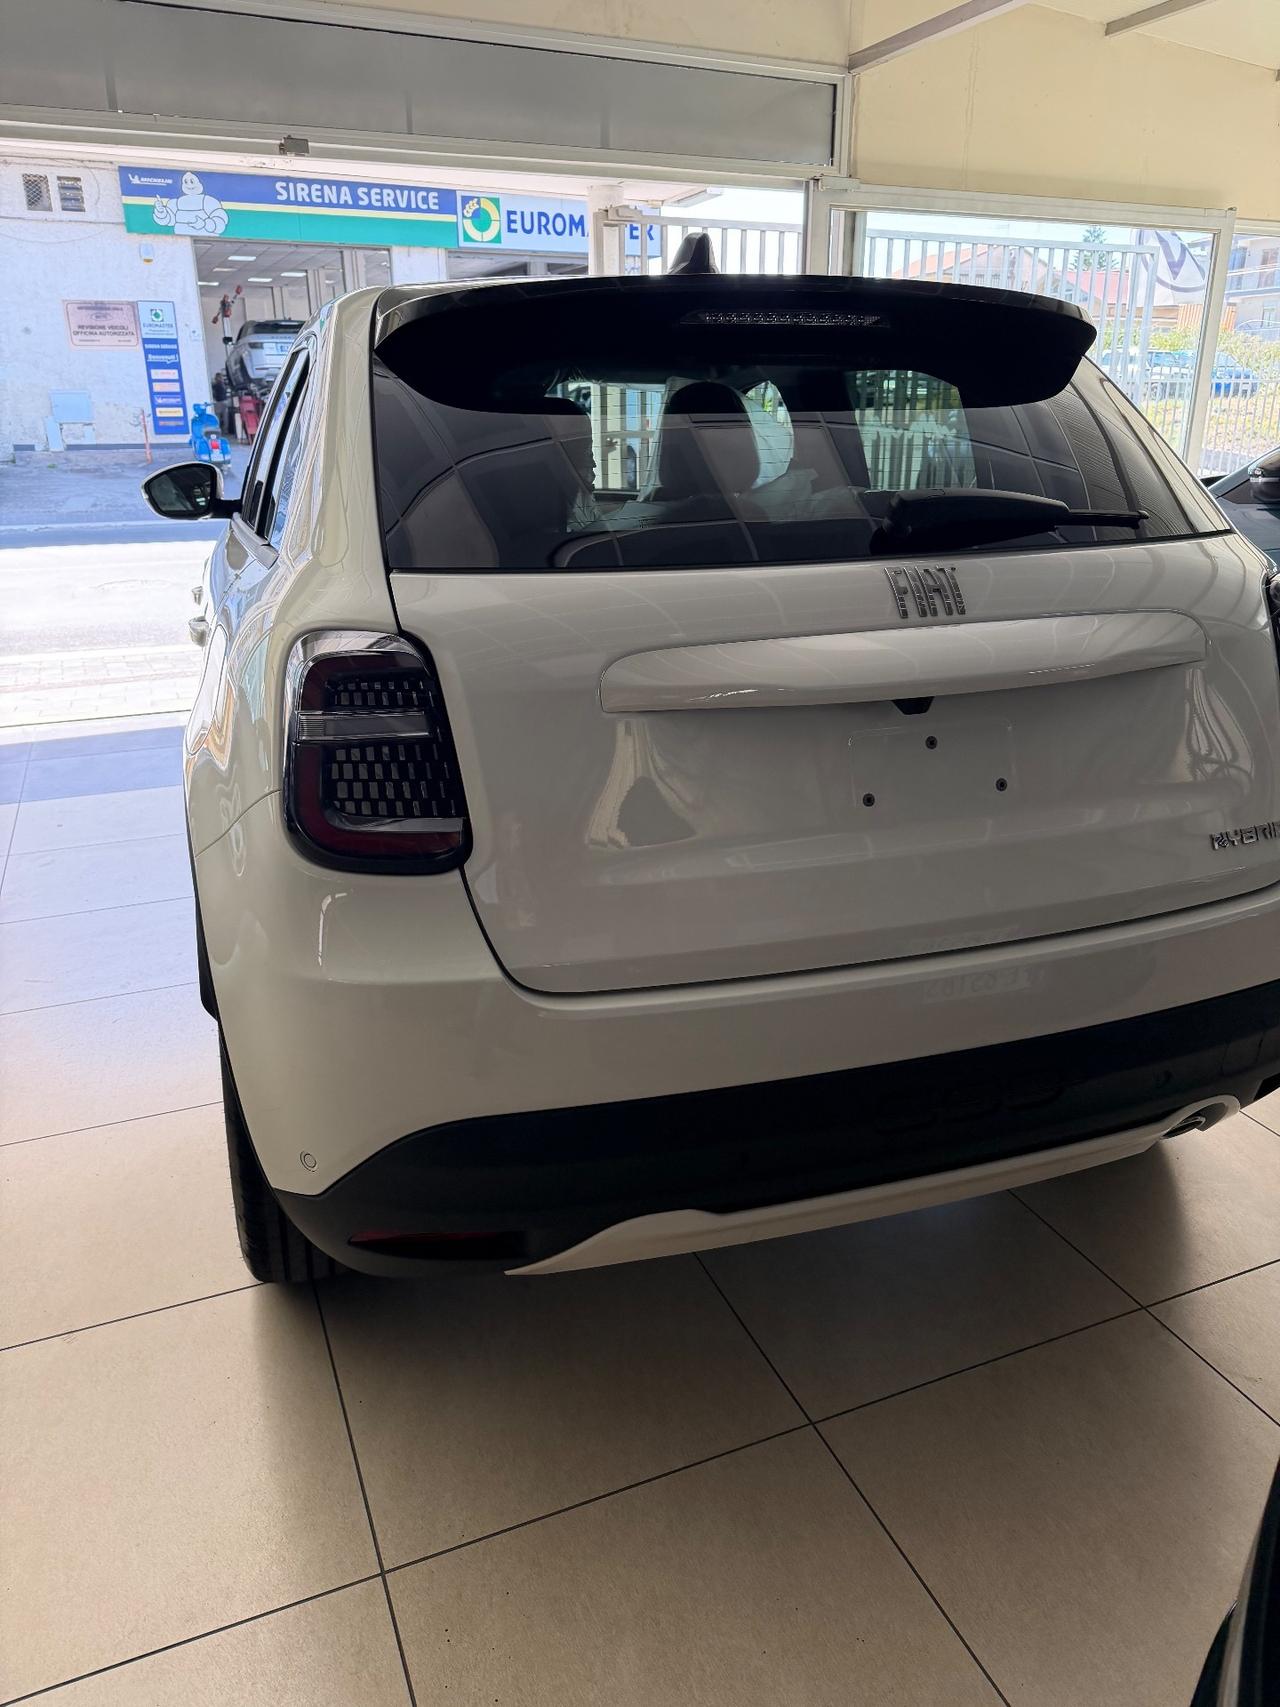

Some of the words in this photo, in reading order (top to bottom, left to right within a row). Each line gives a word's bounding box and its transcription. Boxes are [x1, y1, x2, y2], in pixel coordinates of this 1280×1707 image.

[275, 181, 353, 205] SIRENA
[357, 187, 440, 210] SERVICE
[506, 209, 655, 241] EUROME
[884, 565, 967, 619] FIAT
